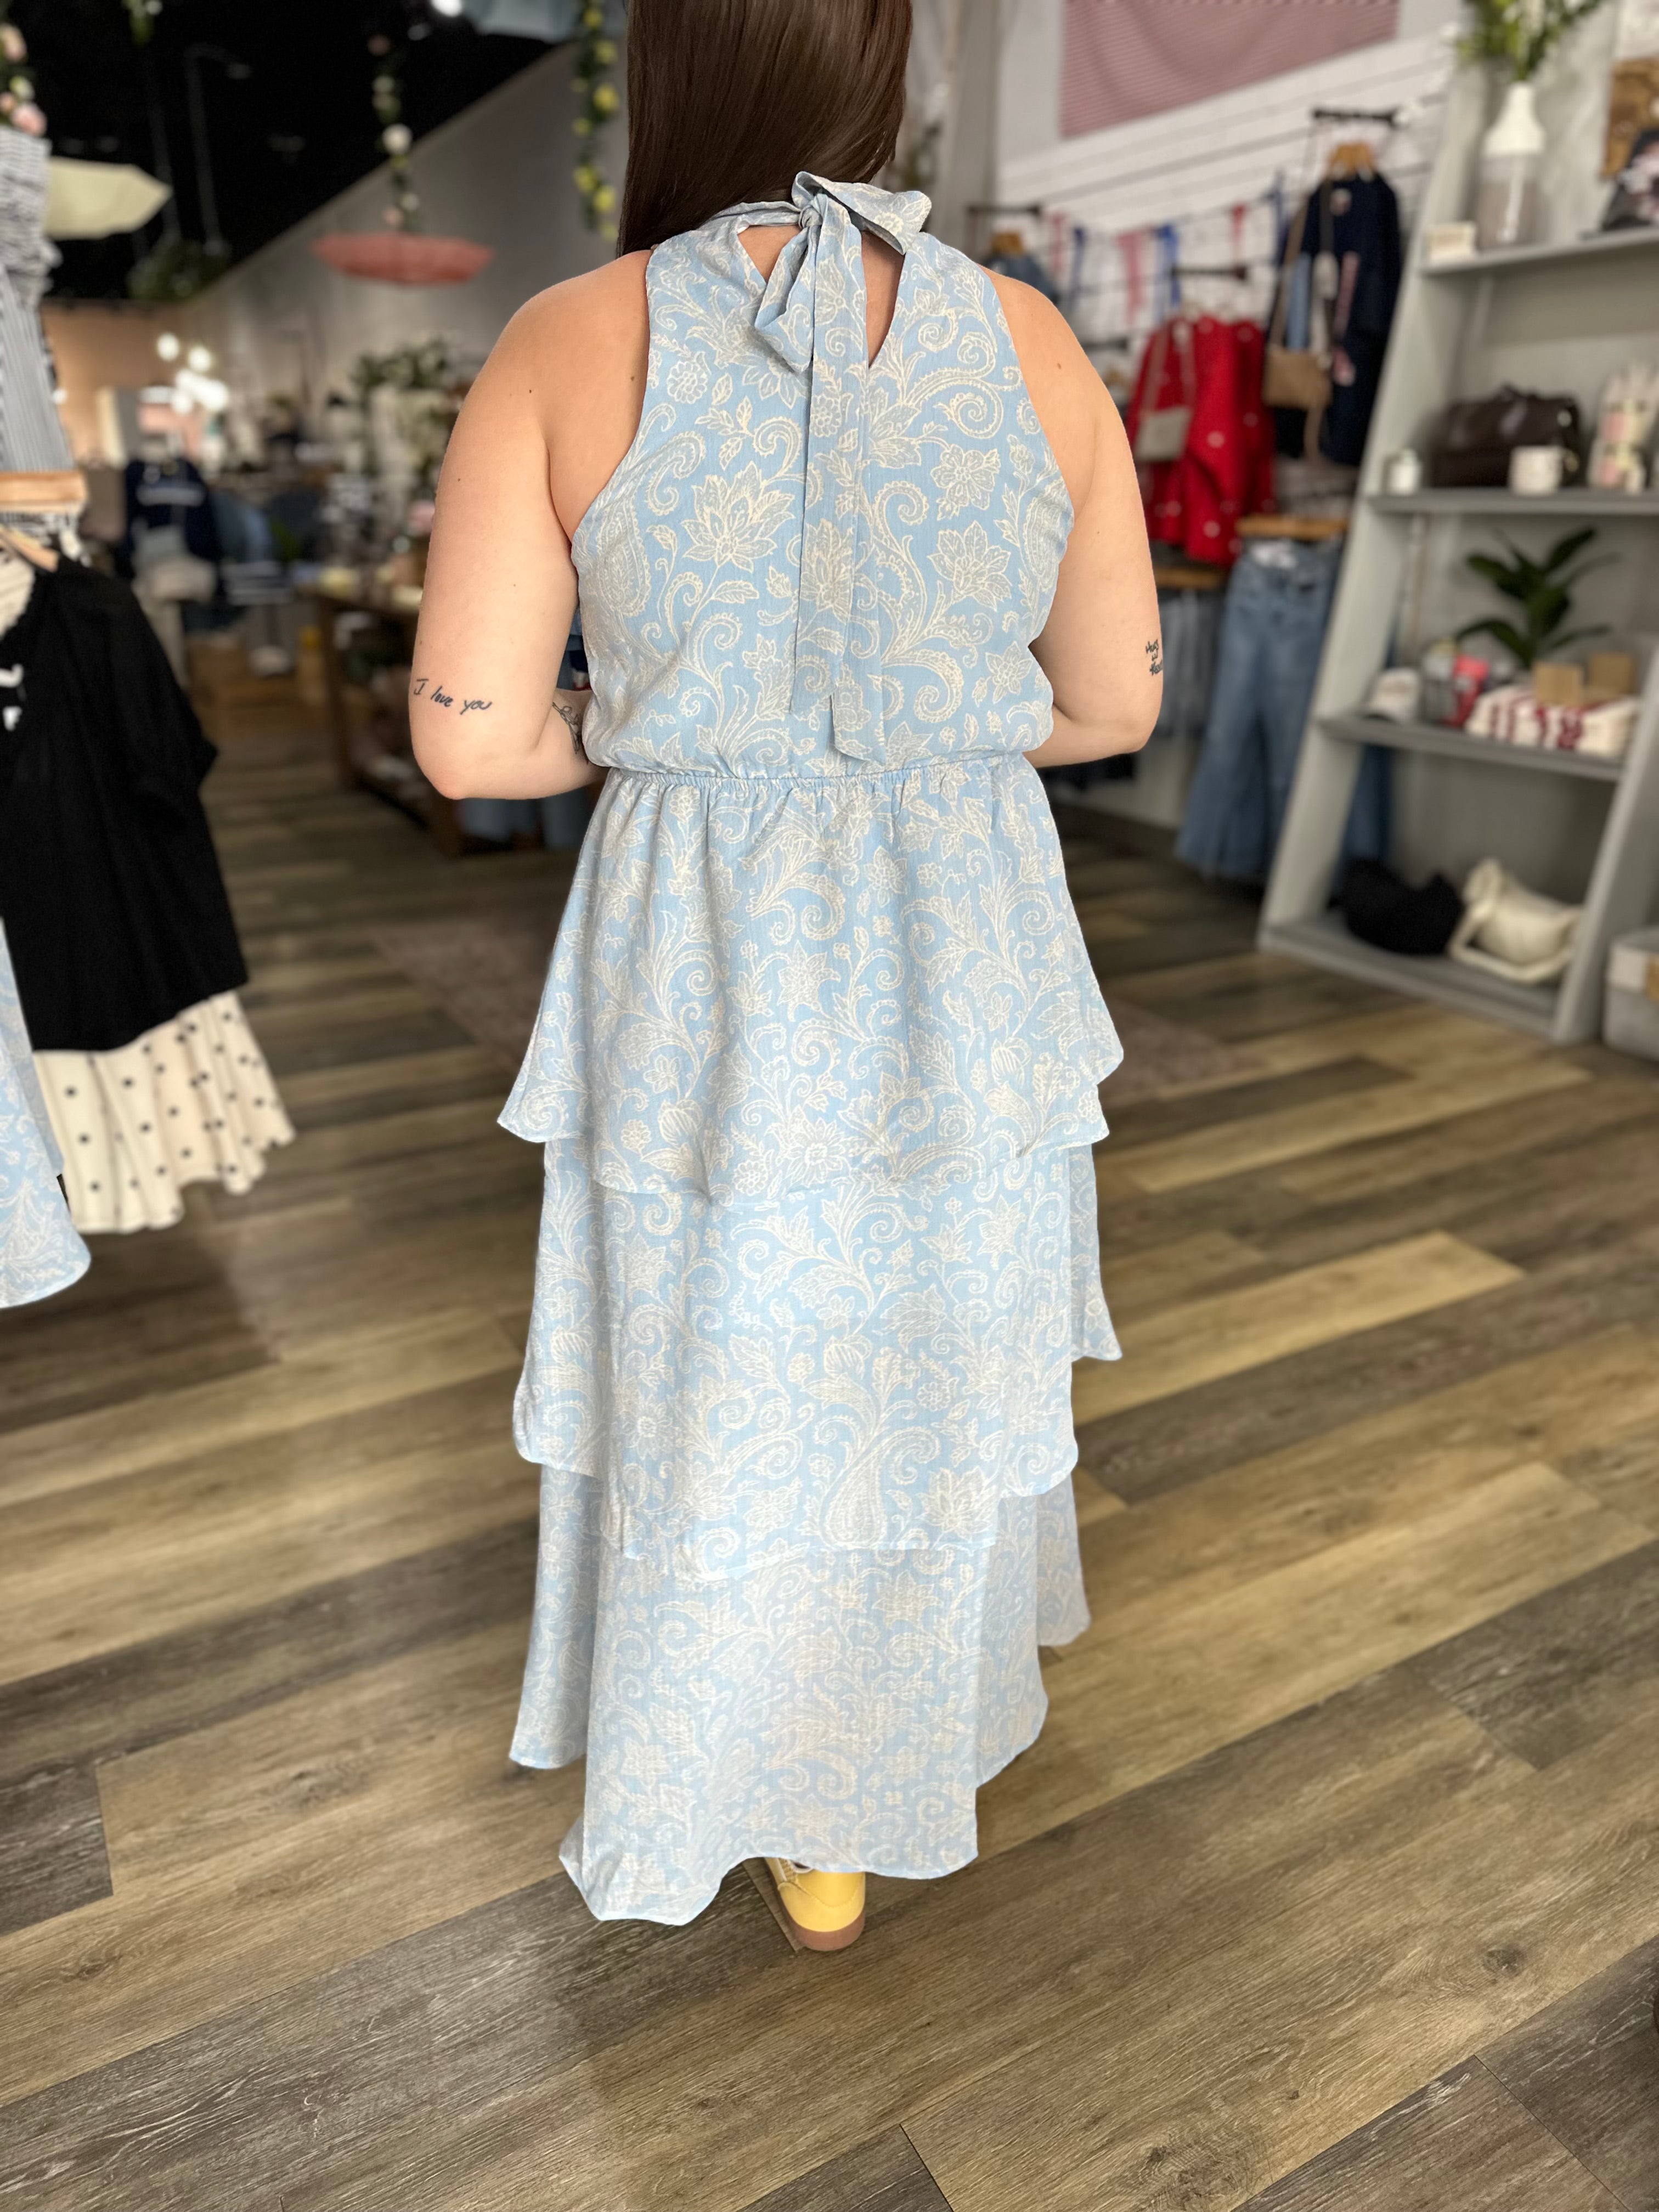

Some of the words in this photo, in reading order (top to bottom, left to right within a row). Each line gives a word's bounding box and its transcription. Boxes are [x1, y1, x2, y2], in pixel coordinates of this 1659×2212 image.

[414, 679, 429, 695] I
[431, 686, 453, 707] love
[460, 699, 493, 715] you
